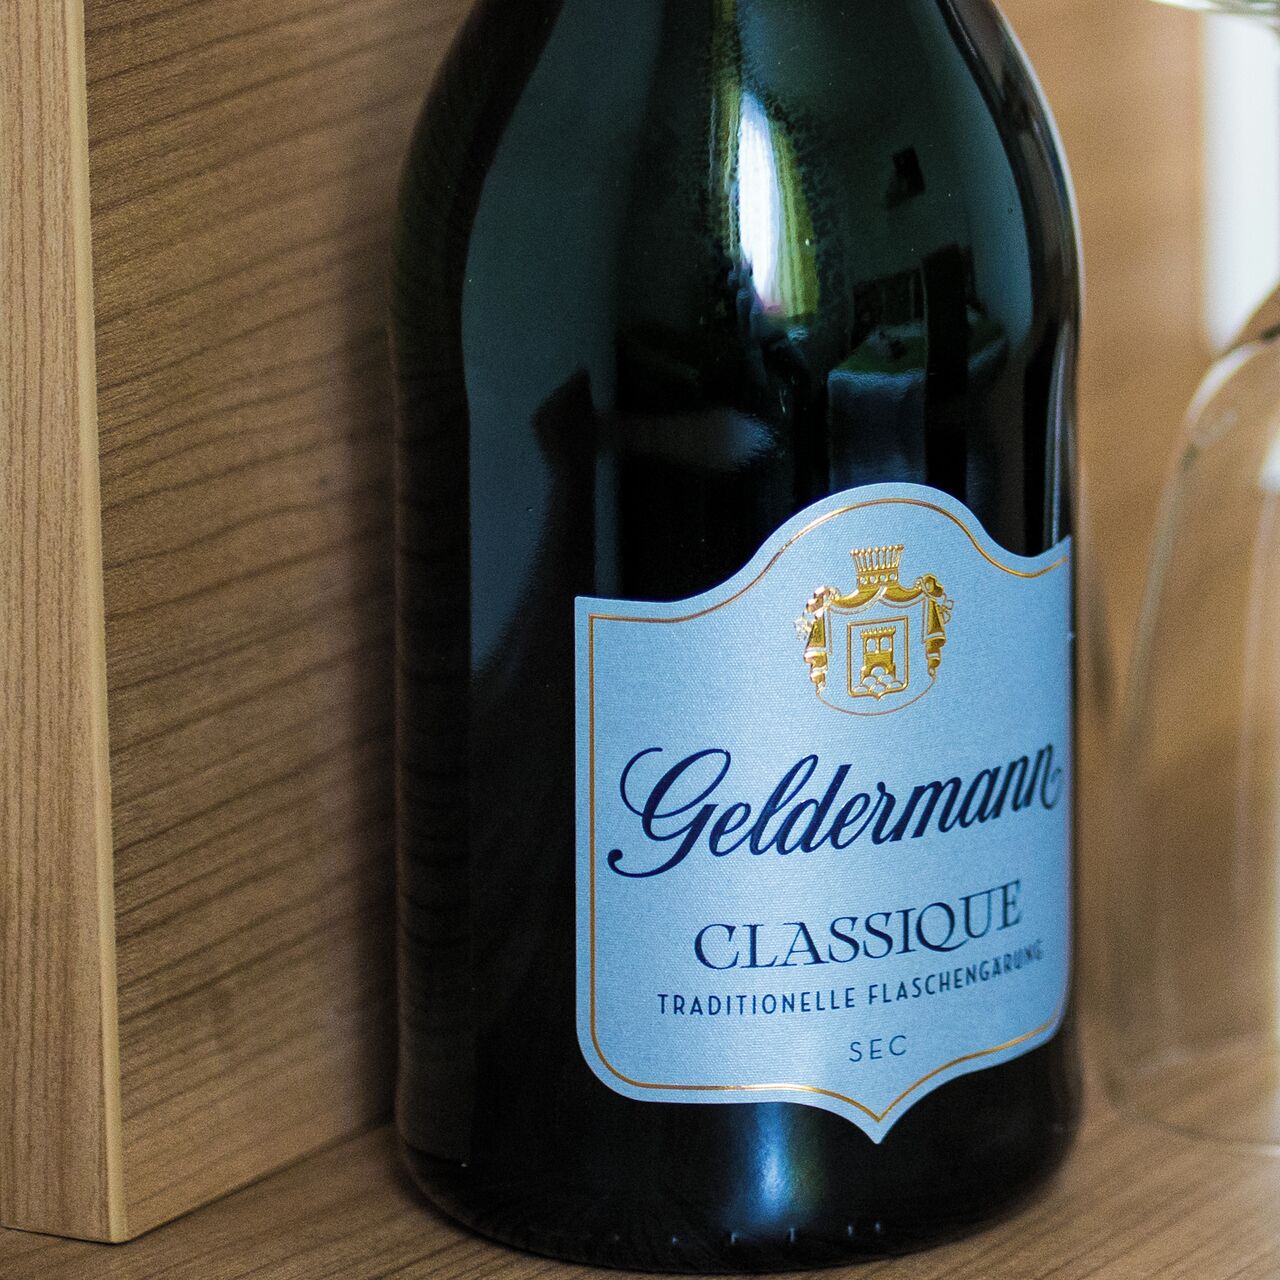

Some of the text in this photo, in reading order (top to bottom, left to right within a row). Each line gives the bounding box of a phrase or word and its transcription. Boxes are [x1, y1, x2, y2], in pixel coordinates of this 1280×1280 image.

[607, 741, 1064, 879] Geldermann
[693, 878, 1023, 971] CLASSIQUE
[657, 987, 856, 1016] TRADITIONELLE
[848, 1035, 908, 1063] SEC
